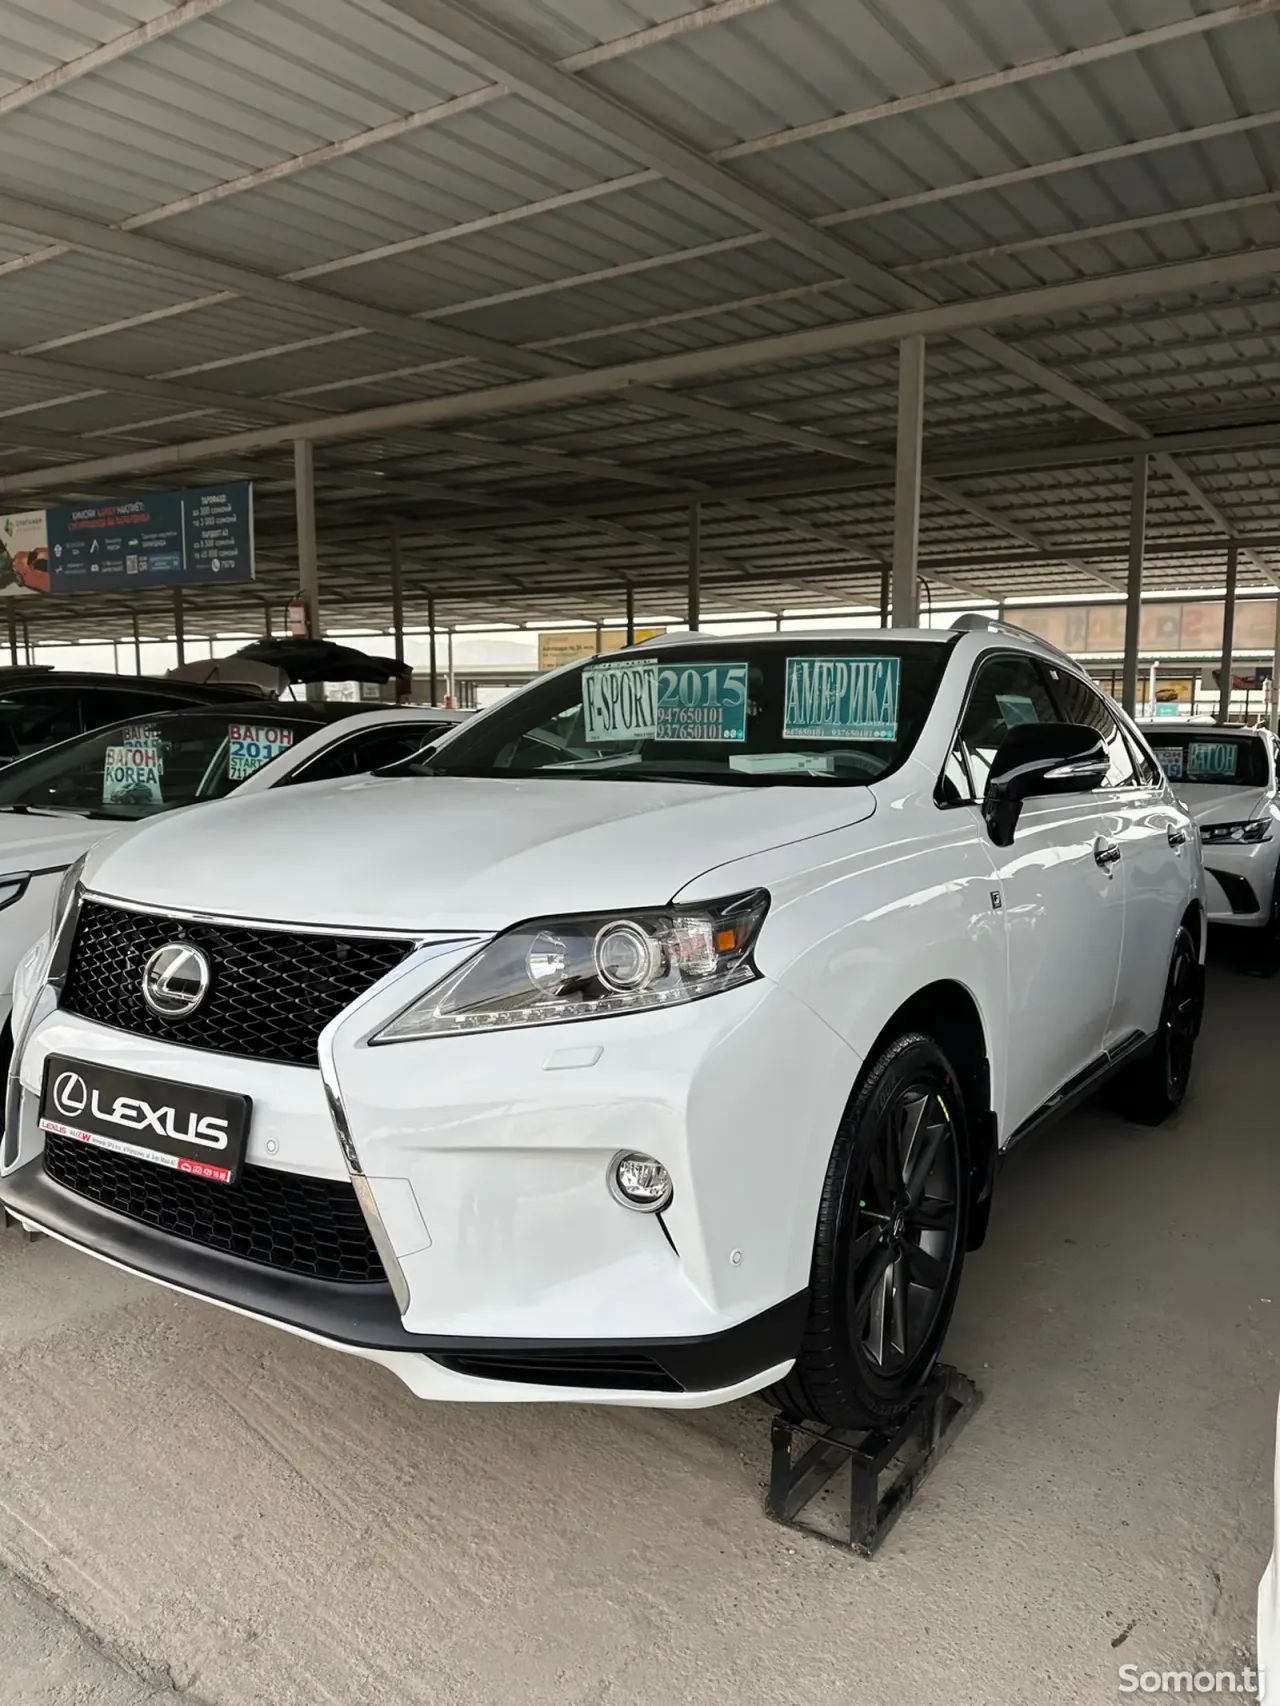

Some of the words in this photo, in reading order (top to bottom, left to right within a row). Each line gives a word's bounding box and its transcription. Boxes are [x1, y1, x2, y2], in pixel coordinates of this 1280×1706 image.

[658, 668, 747, 707] 2015
[786, 661, 896, 725] АМЕРИКА
[586, 669, 656, 732] F-SPORT
[658, 707, 723, 723] 947650101
[230, 724, 291, 745] ВАГОН
[658, 724, 723, 739] 937650101
[106, 748, 157, 767] ВАГОН
[230, 756, 263, 768] START
[105, 767, 157, 784] KOREA
[91, 1088, 228, 1150] LEXUS
